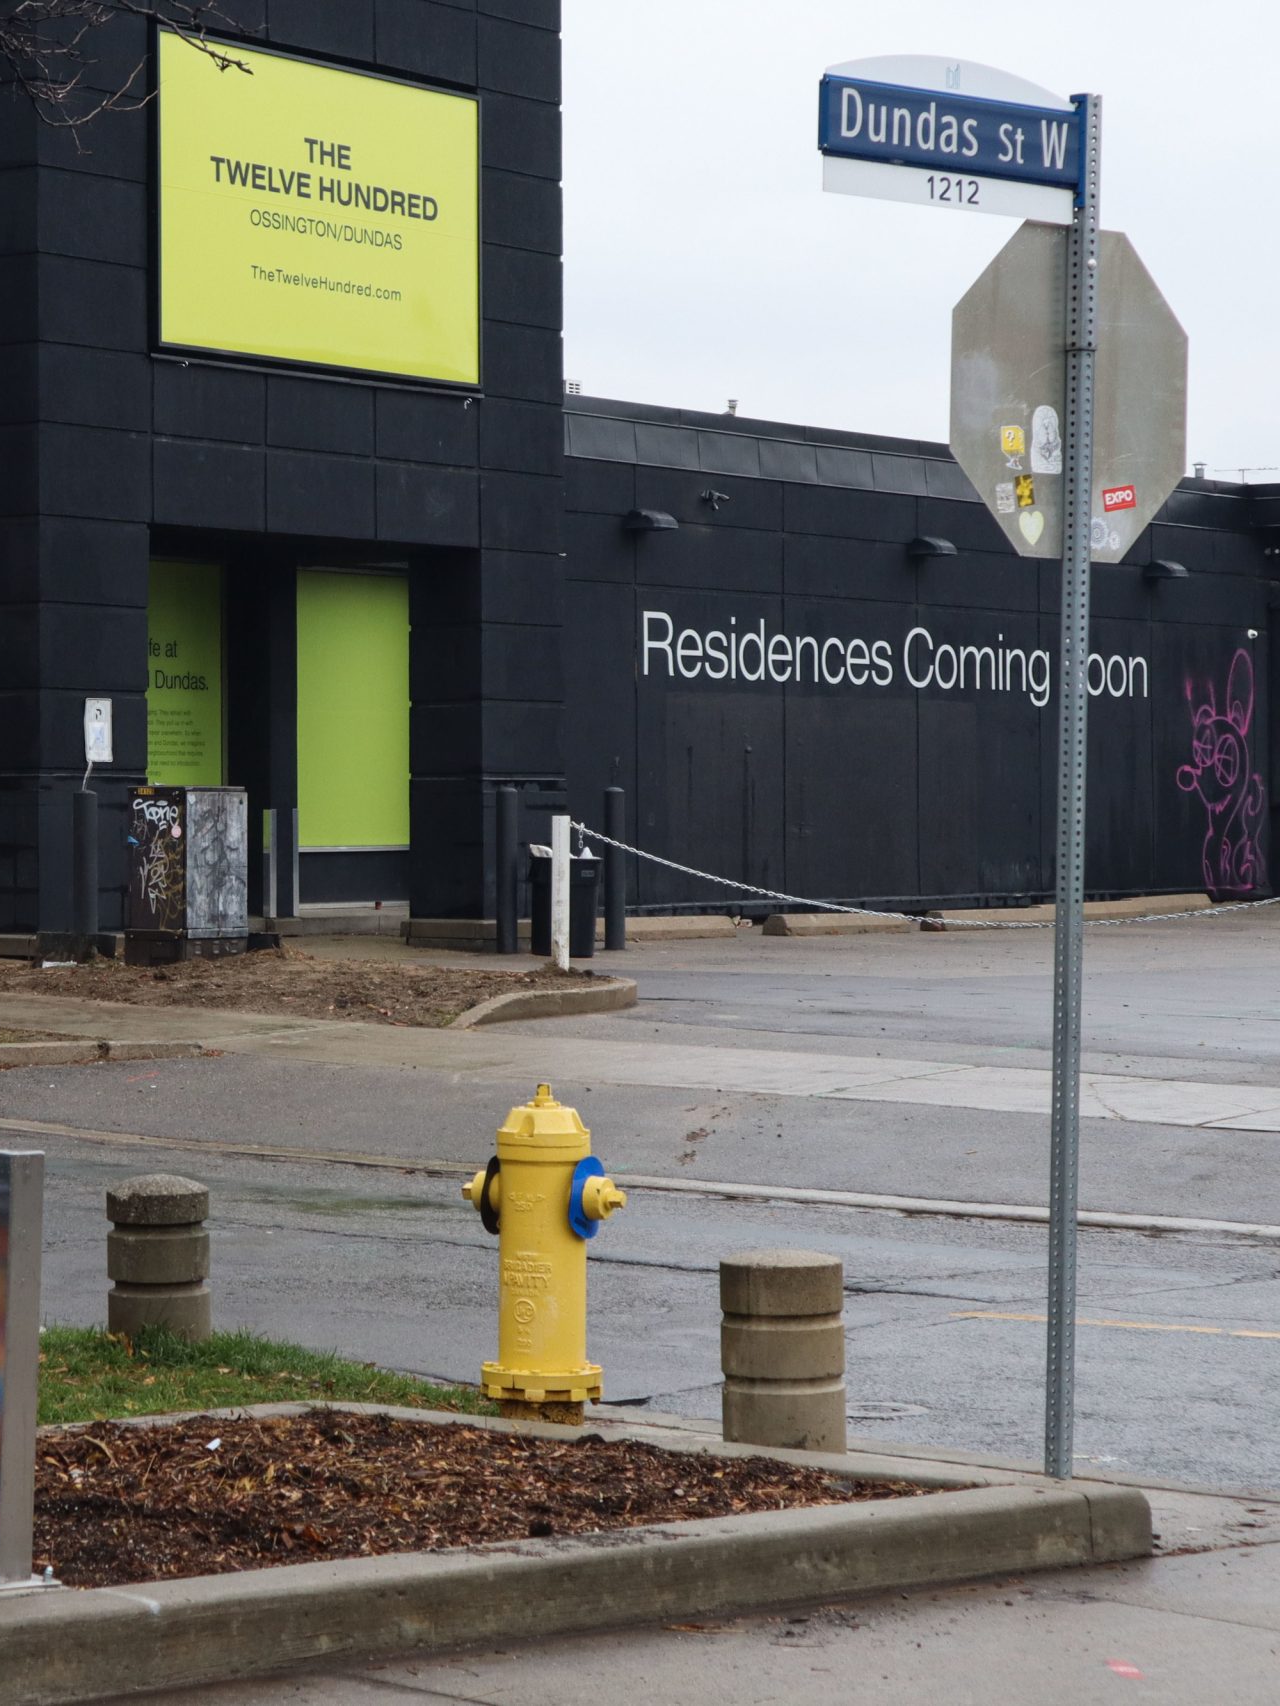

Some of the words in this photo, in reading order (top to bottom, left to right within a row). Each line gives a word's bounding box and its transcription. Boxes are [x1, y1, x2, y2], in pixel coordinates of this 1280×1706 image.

[840, 87, 979, 158] Dundas
[998, 123, 1025, 165] St
[1041, 119, 1069, 170] W
[304, 137, 352, 171] THE
[210, 155, 312, 199] TWELVE
[319, 175, 439, 221] HUNDRED
[927, 175, 980, 205] 1212
[249, 208, 403, 251] OSSINGTON/DUNDAS
[251, 265, 402, 302] TheTwelveHundred.com
[1104, 489, 1133, 505] EXPO
[165, 639, 178, 658] at
[641, 610, 894, 687] Residences
[903, 626, 1051, 707] Coming
[1087, 652, 1148, 698] oon
[154, 669, 209, 691] Dundas.
